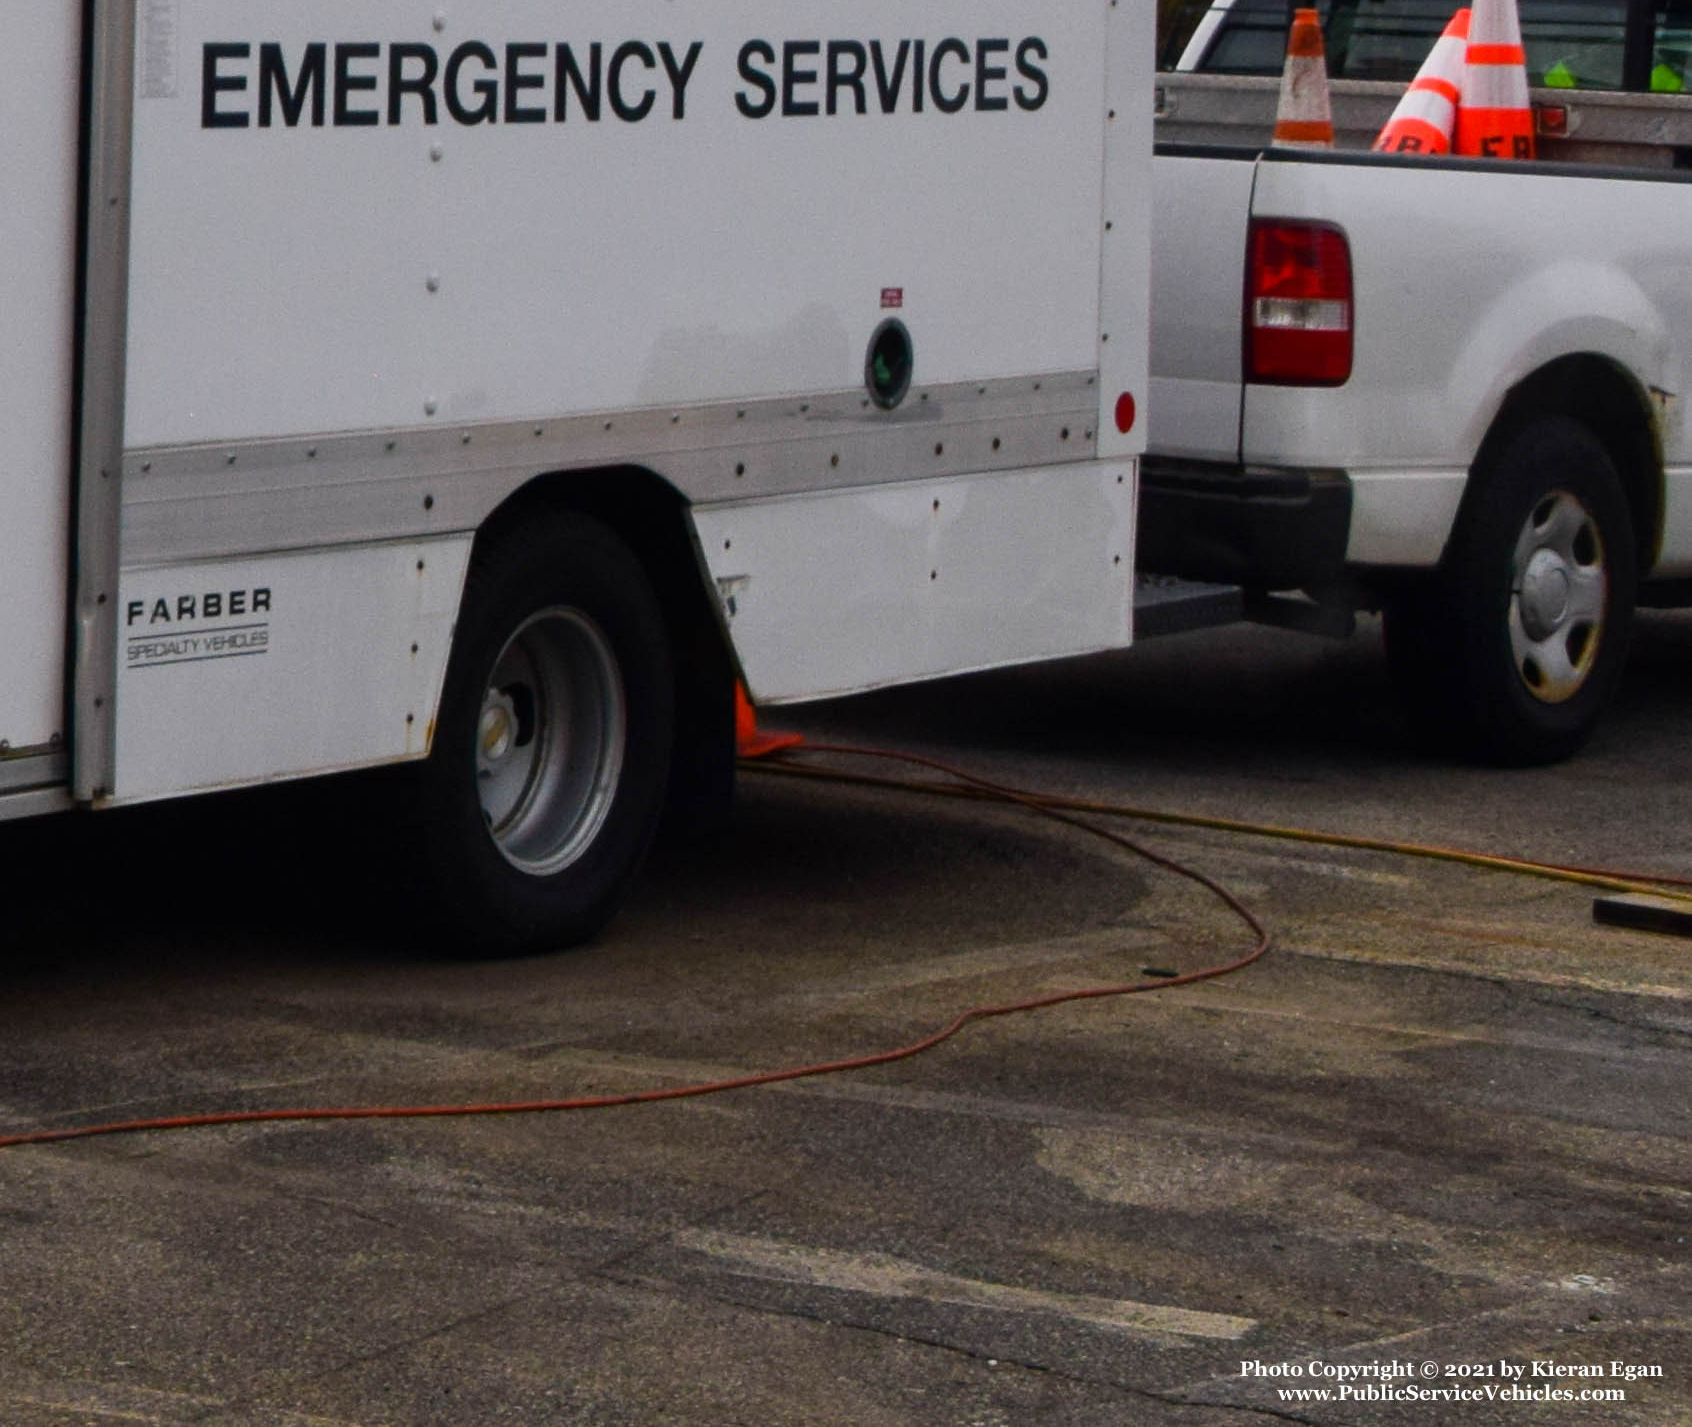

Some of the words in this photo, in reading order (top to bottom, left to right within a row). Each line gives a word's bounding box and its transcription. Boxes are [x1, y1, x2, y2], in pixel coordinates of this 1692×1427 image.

[200, 40, 703, 129] EMERGENCY
[735, 35, 1050, 118] SERVICES
[126, 587, 271, 626] FARBER
[126, 636, 202, 661] SPECIALTY
[203, 630, 270, 650] VEHICLES
